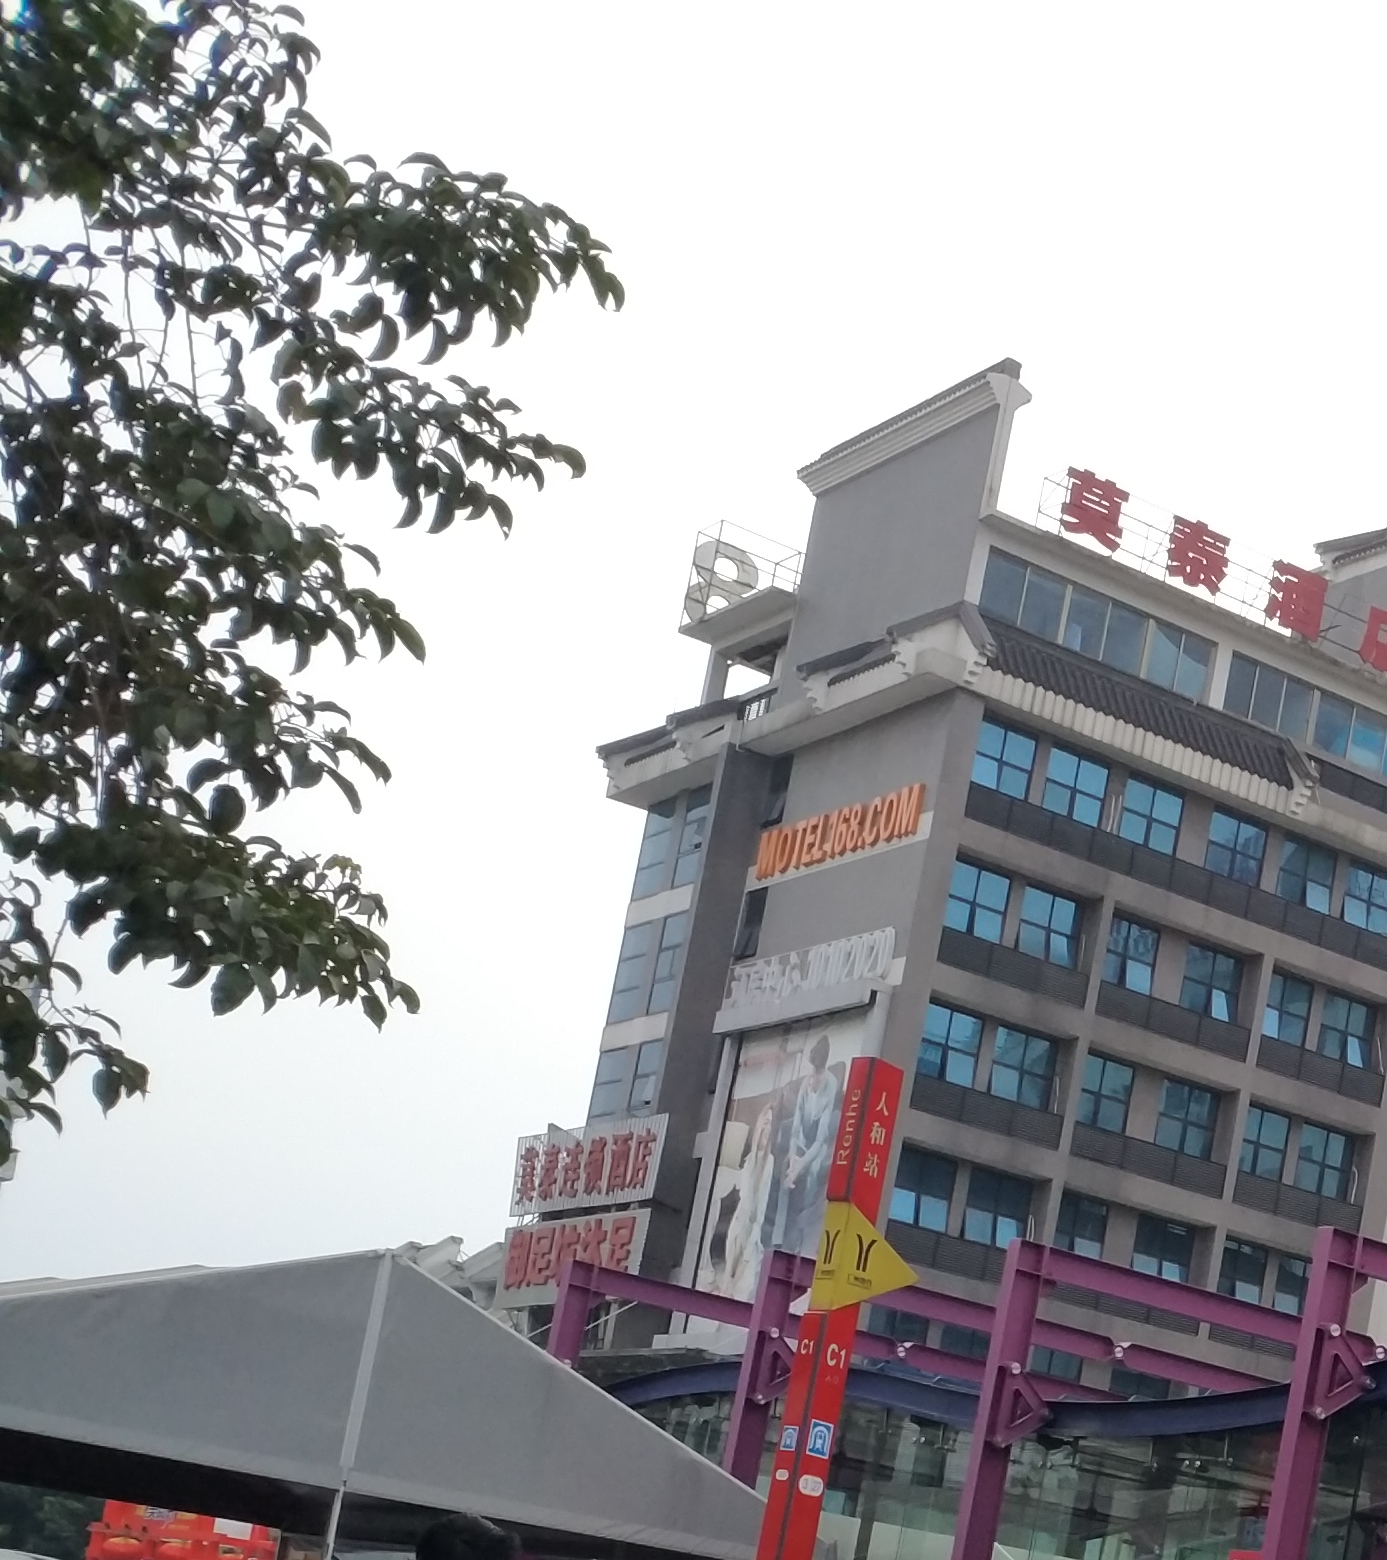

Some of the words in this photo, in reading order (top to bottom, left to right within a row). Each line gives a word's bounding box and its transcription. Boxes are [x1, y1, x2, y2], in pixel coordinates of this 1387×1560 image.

[836, 1087, 862, 1166] Renhe
[863, 1091, 890, 1180] 人和站
[800, 1338, 814, 1355] C1
[826, 1343, 847, 1369] C1
